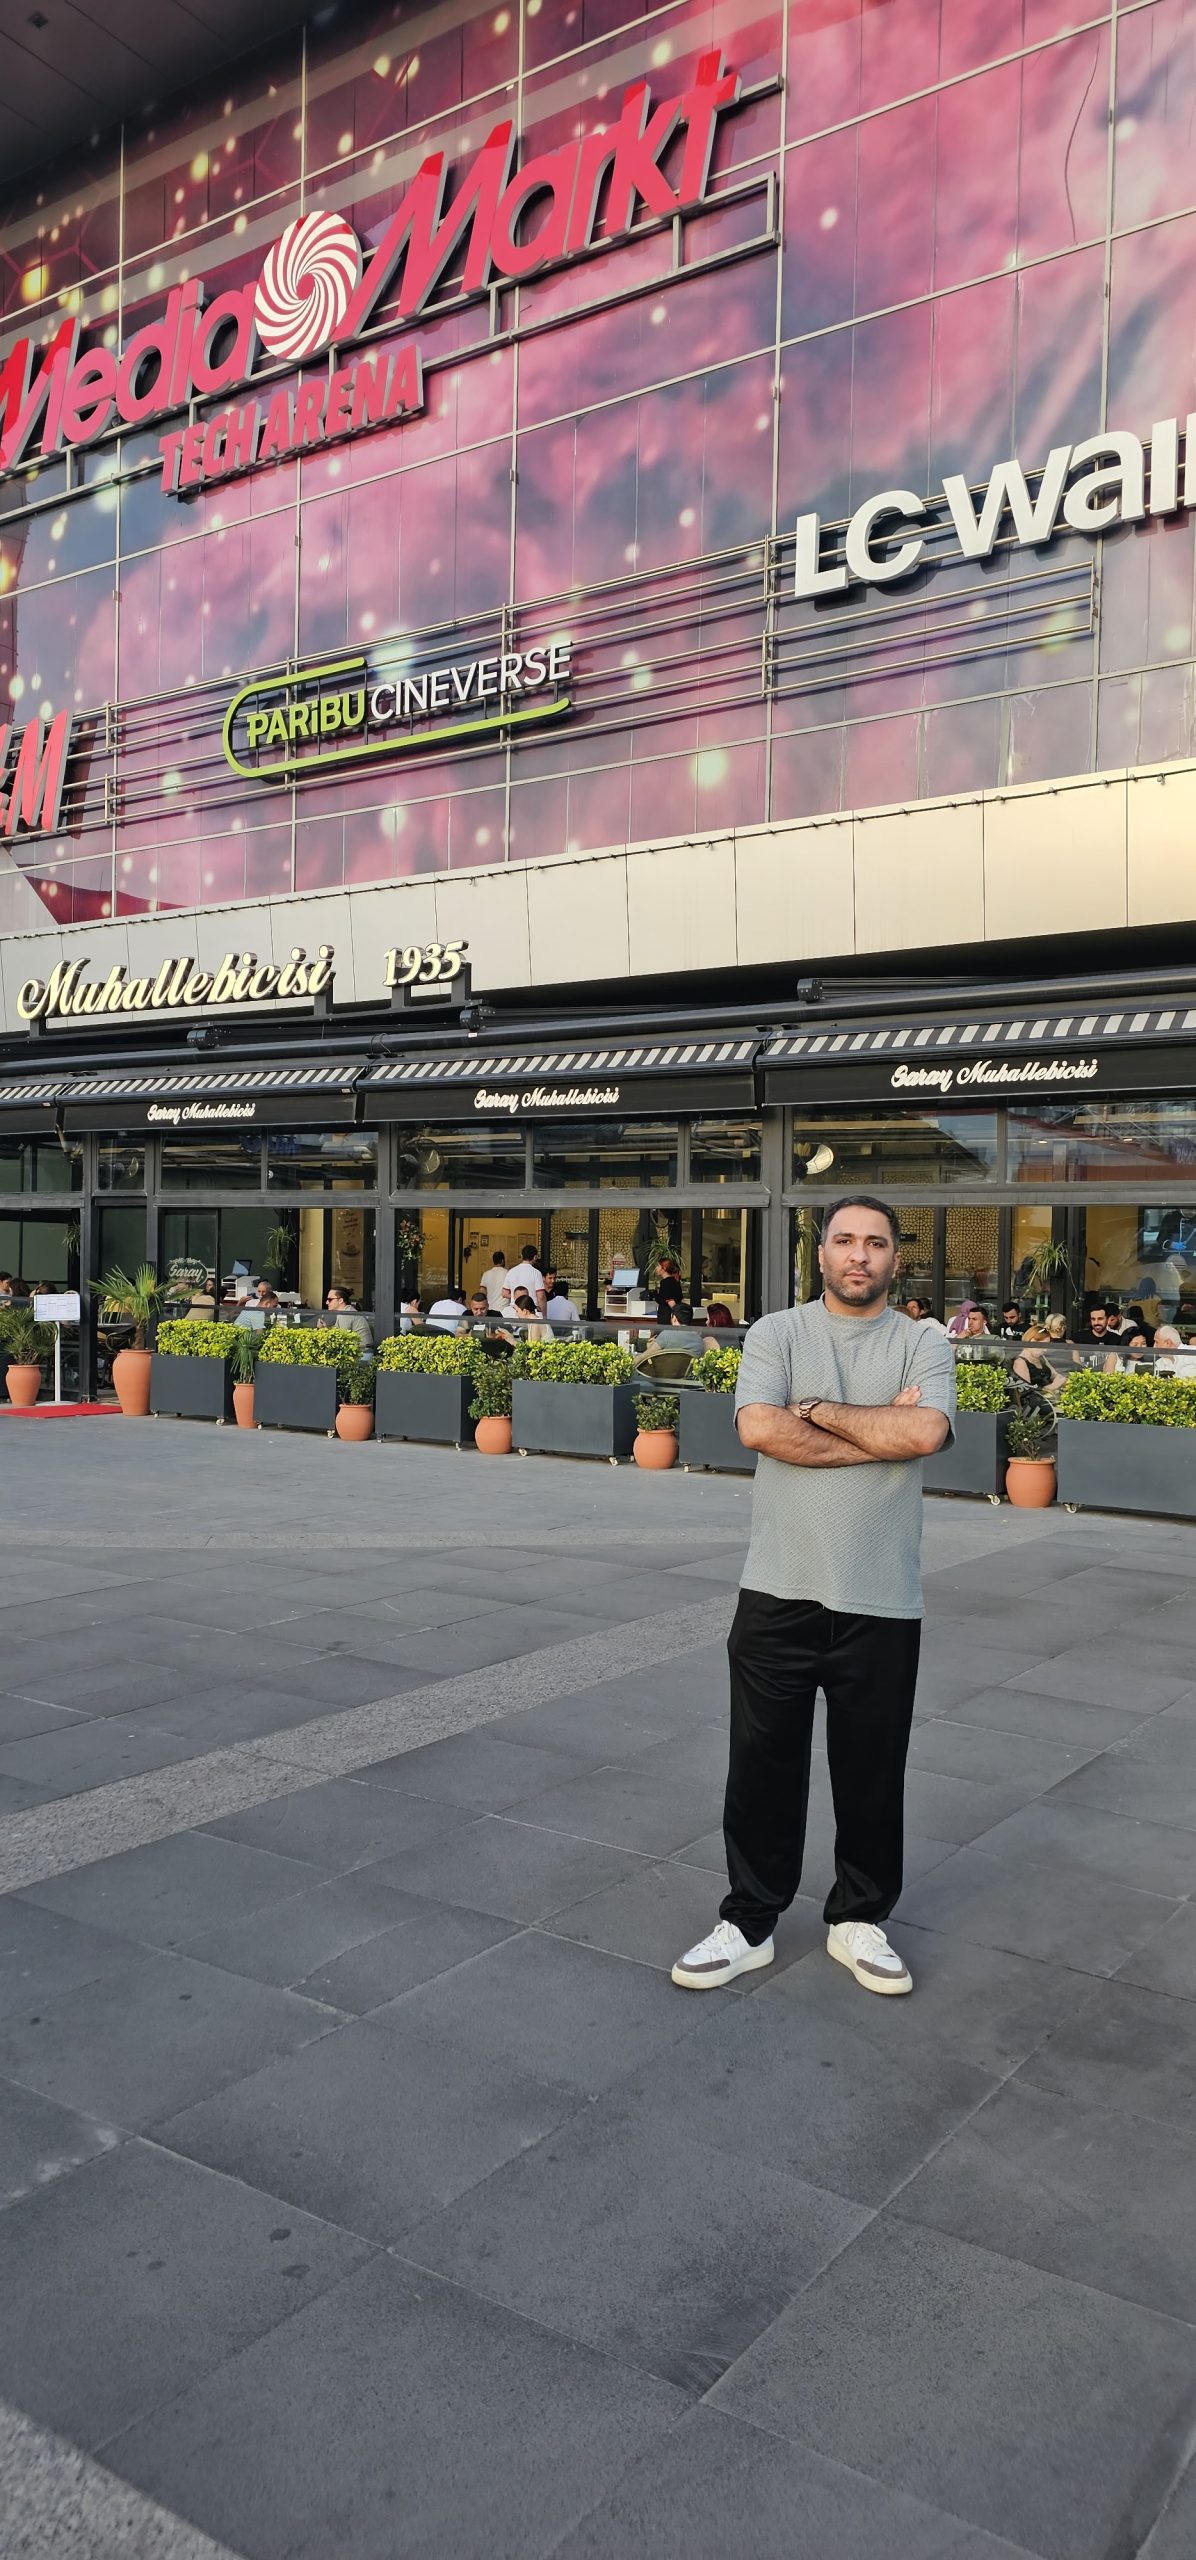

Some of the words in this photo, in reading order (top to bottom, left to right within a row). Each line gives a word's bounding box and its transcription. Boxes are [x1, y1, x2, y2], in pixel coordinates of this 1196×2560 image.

[331, 49, 740, 343] Markt
[159, 400, 261, 494] TECH
[259, 344, 424, 458] ARENA
[795, 489, 926, 597] LC
[371, 640, 574, 720] CINEVERSE
[16, 945, 335, 1020] Muhallebicisi
[383, 940, 469, 987] 1935
[147, 1104, 181, 1125] Saray
[474, 1088, 519, 1114] Saray
[521, 1087, 620, 1108] Muhallebicisi
[890, 1065, 953, 1093] Saray
[957, 1059, 1099, 1085] Muhallebicisi
